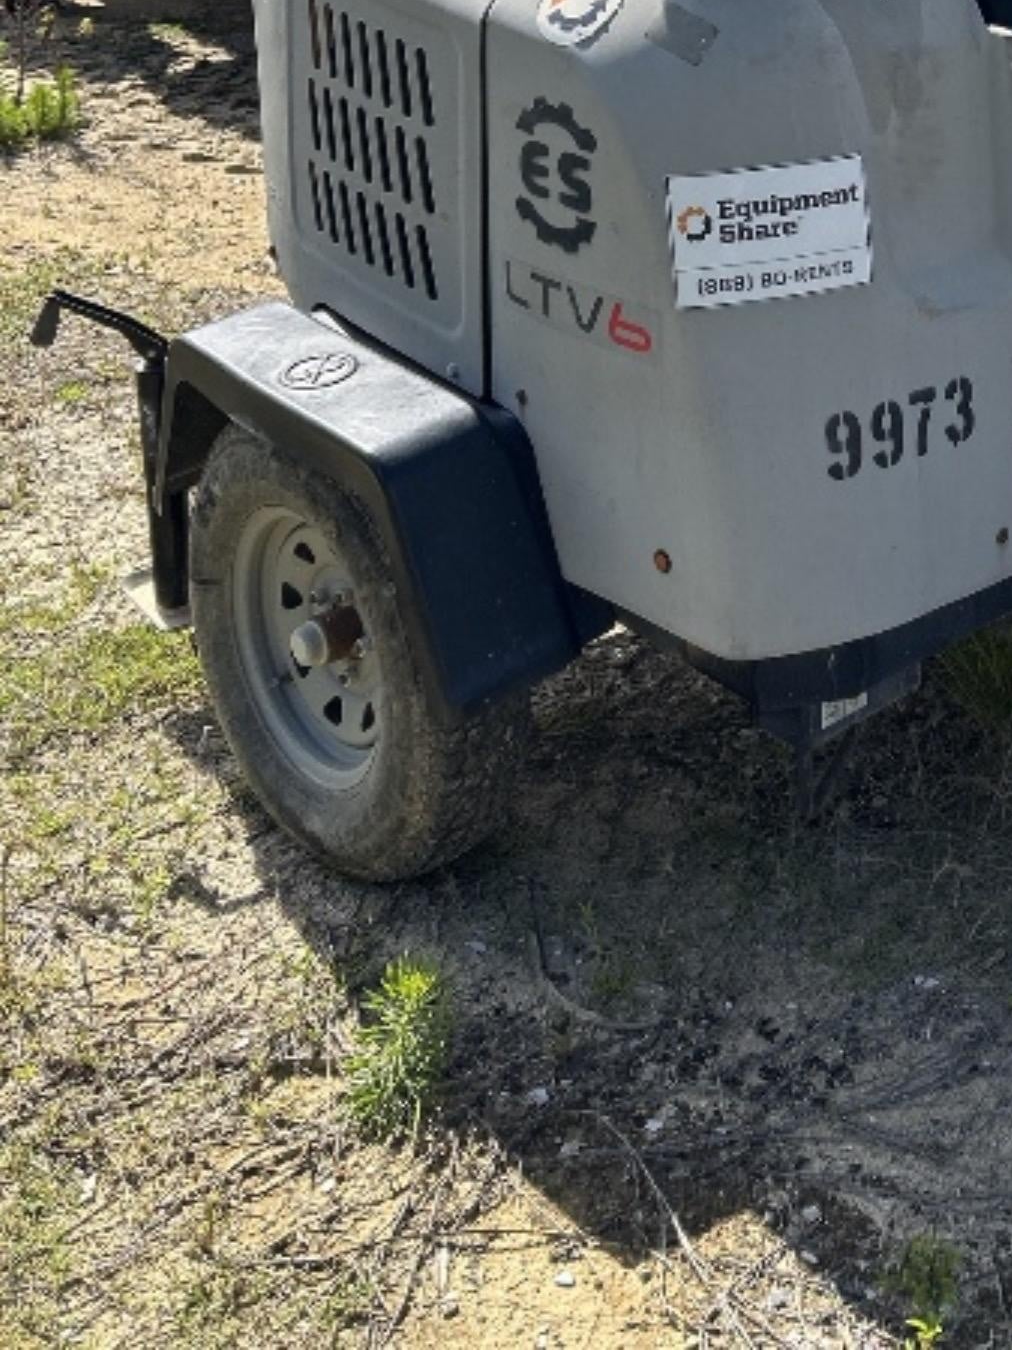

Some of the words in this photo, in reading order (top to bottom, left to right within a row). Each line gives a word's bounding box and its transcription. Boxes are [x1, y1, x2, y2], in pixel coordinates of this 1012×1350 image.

[518, 139, 592, 214] ES
[716, 183, 860, 222] Equipment
[719, 220, 798, 244] Share
[825, 375, 976, 481] 9973
